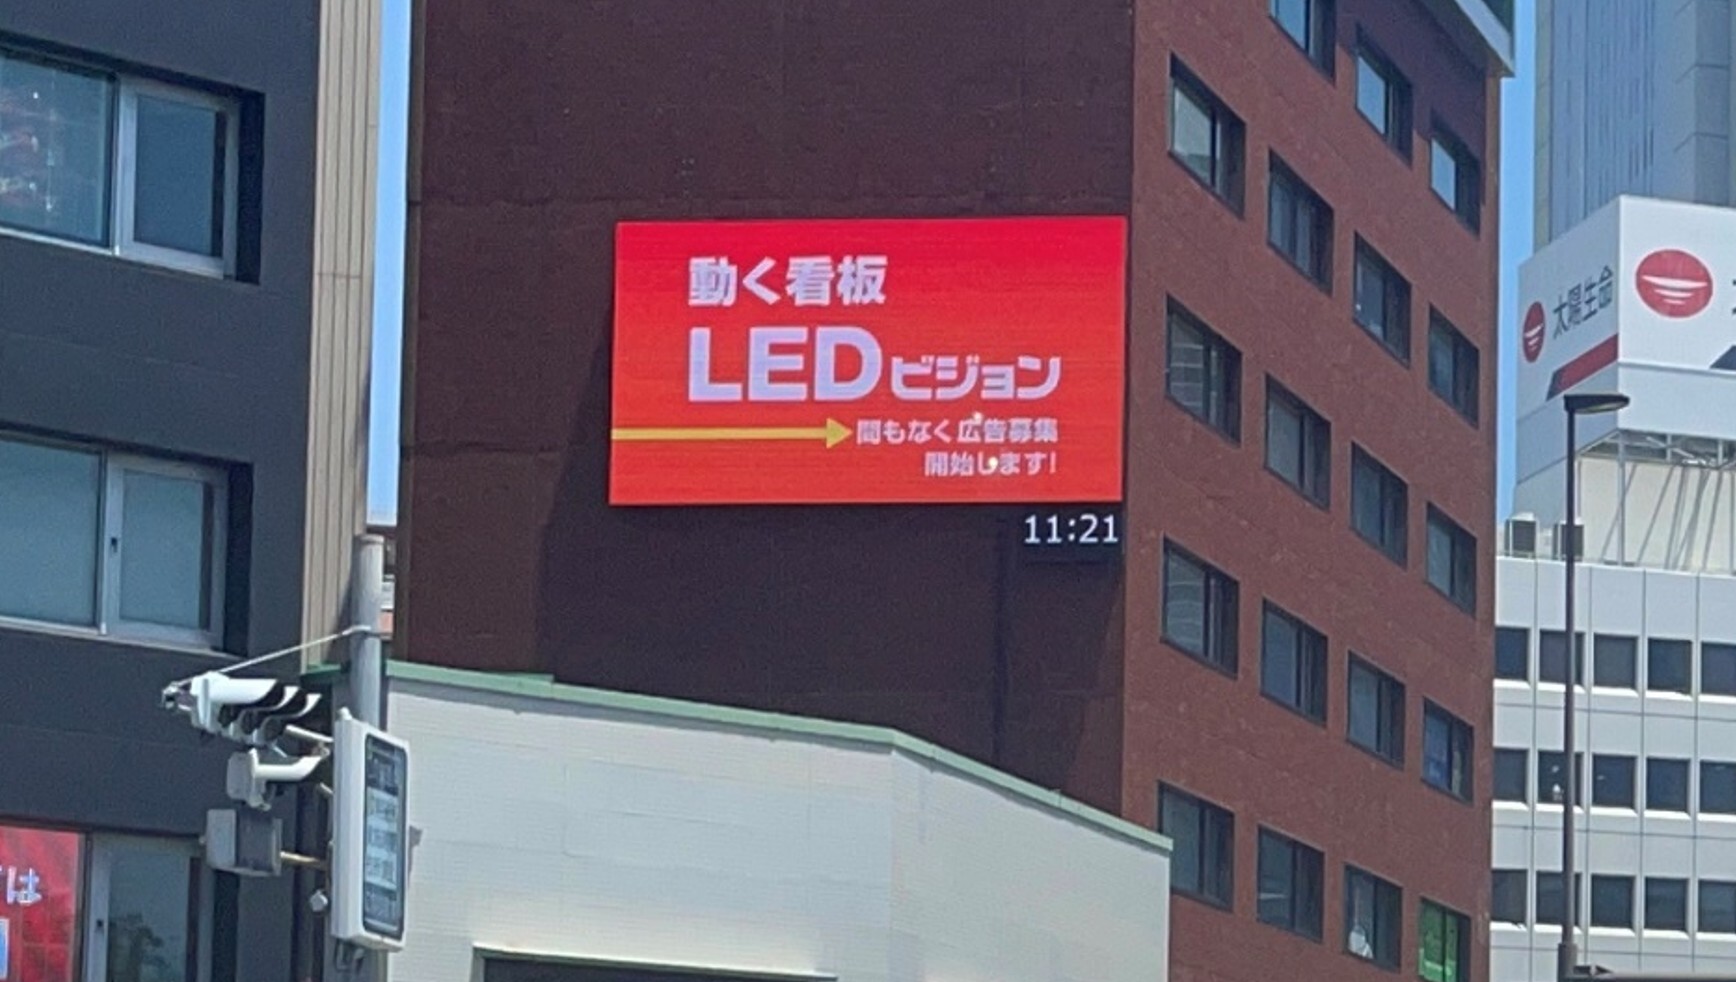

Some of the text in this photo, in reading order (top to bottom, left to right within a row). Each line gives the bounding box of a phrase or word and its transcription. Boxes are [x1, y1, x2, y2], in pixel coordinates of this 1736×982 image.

[687, 255, 889, 307] 動く看板
[1552, 264, 1615, 341] 太陽生命
[856, 417, 1059, 446] 間もなく広告募集
[1023, 515, 1119, 544] 11:21
